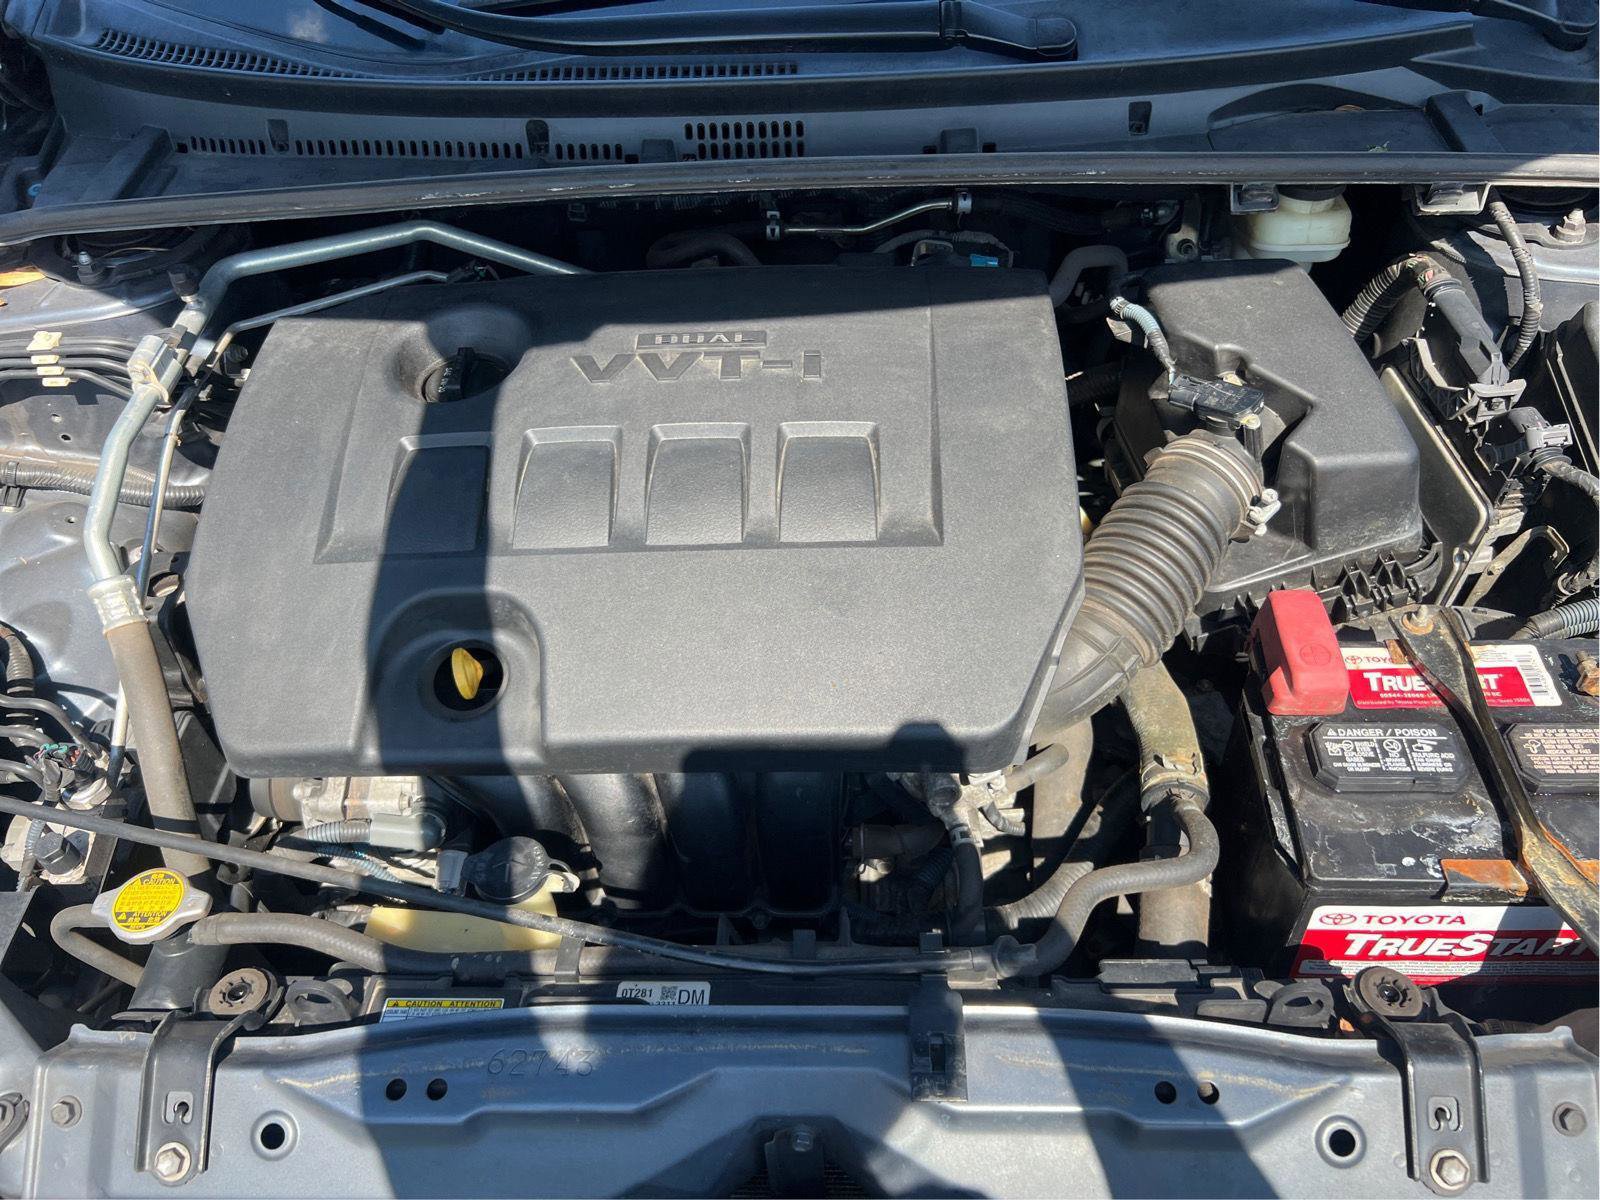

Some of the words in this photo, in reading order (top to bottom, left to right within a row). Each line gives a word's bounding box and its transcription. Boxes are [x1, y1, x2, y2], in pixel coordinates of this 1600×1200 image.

[654, 332, 755, 345] DUAL
[1337, 728, 1384, 736] DANGER
[1394, 728, 1437, 737] POISON
[1362, 914, 1466, 926] TOYOTA
[677, 989, 706, 1005] DM
[405, 1000, 442, 1008] CAUTION
[449, 999, 496, 1008] ATTENTION
[488, 1048, 594, 1077] 62743
